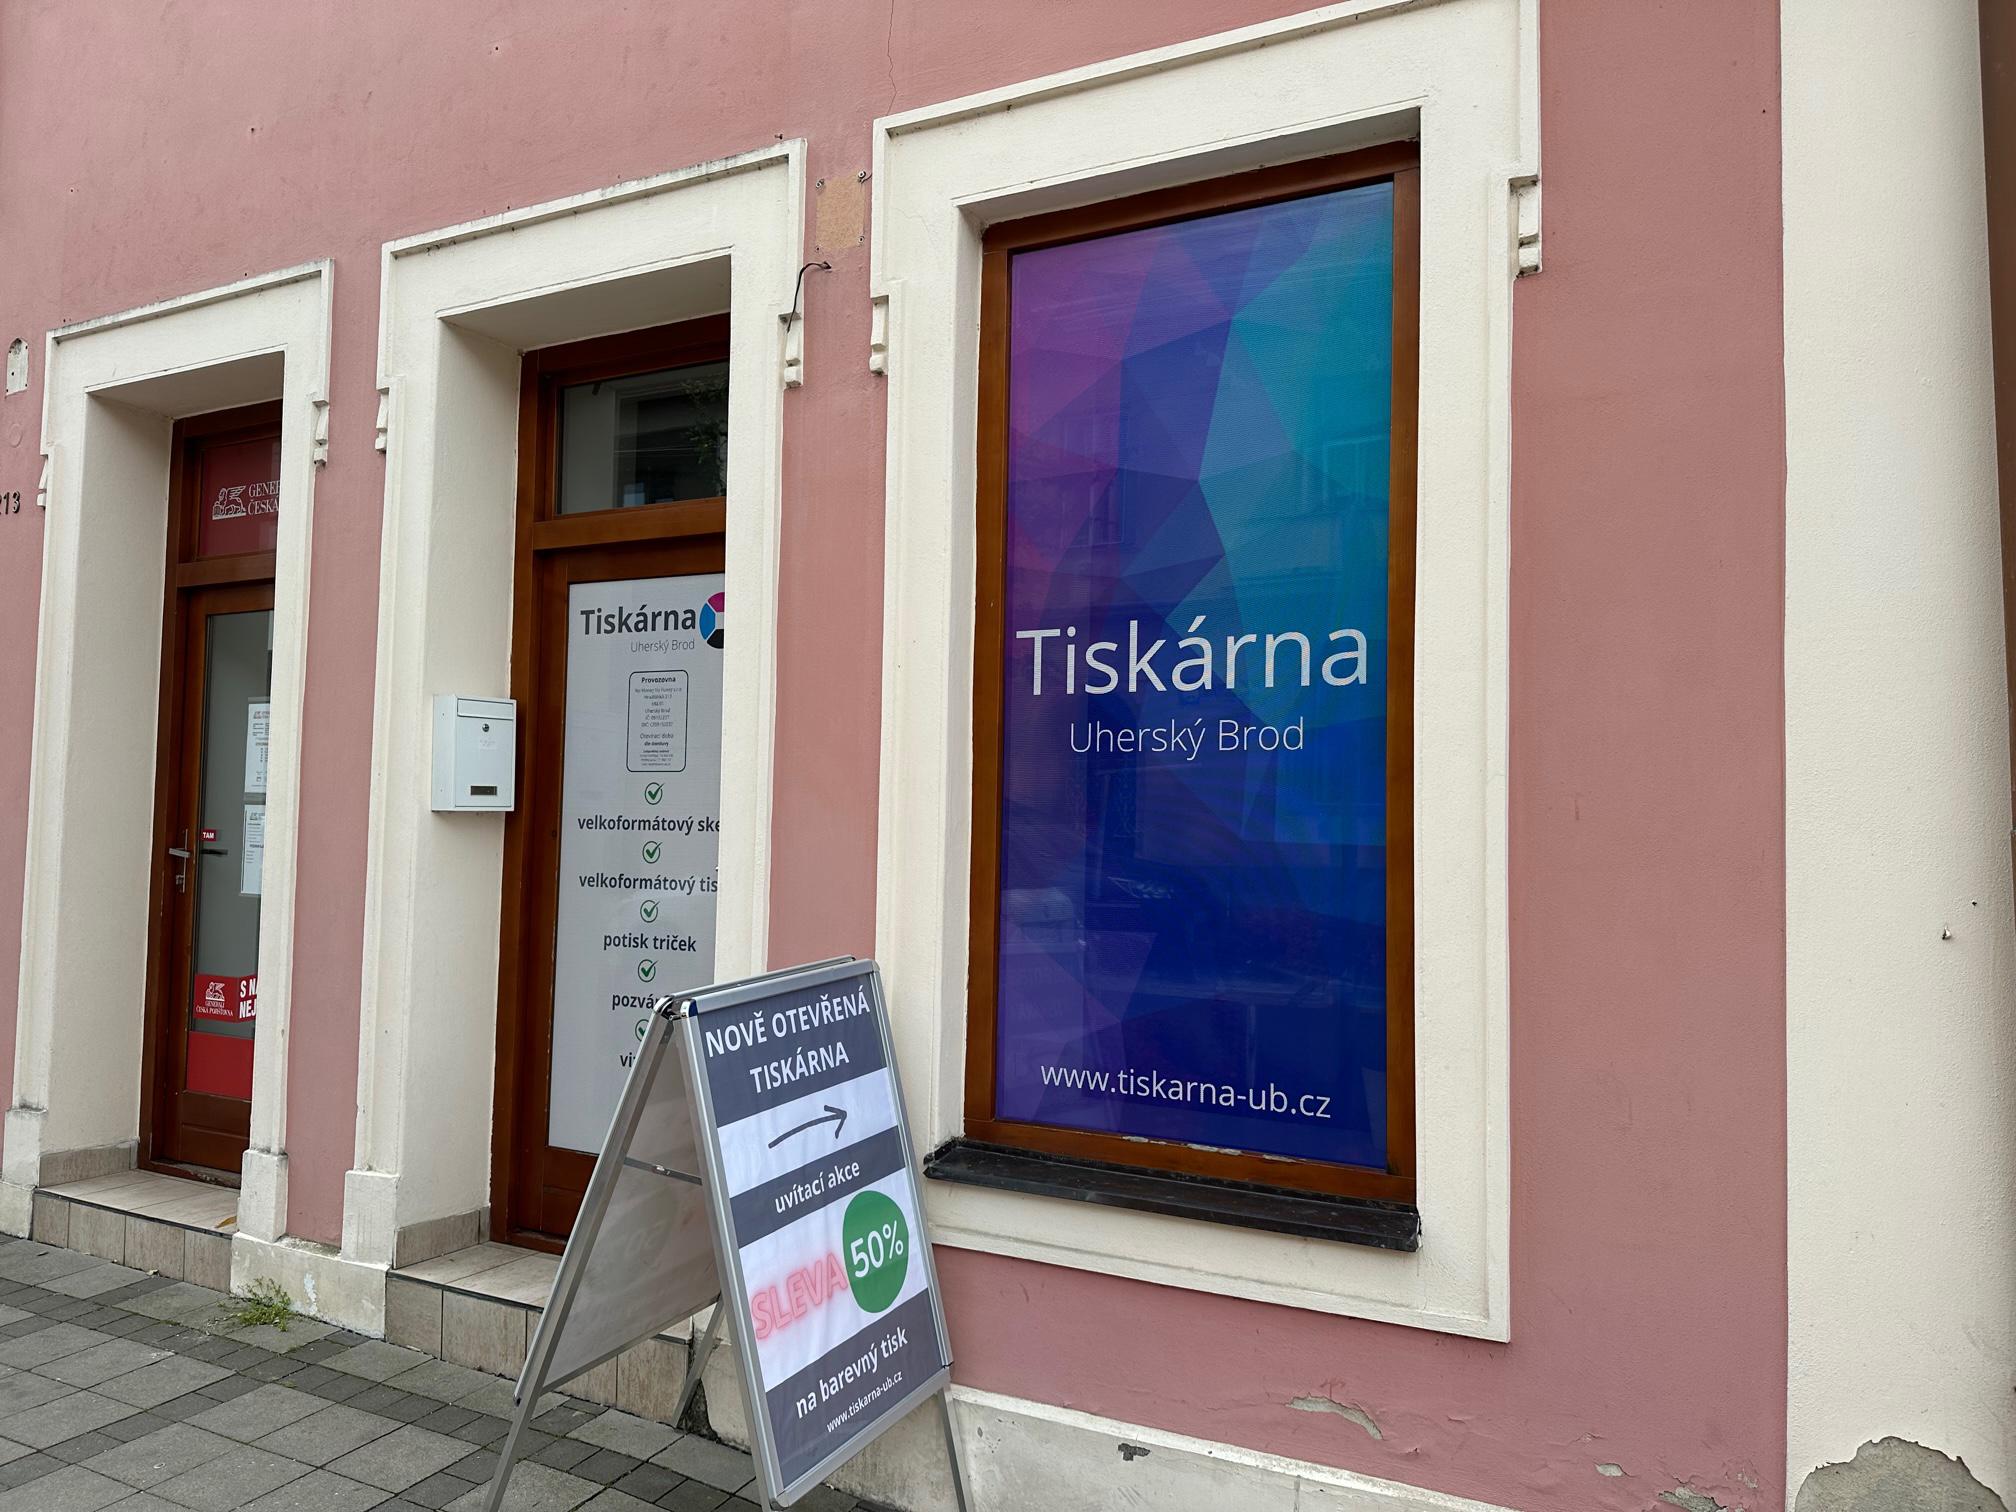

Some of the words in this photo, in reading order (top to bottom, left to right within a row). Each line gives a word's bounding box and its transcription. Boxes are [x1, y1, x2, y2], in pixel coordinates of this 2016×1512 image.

[0, 491, 21, 515] 13
[580, 604, 696, 635] Tiskárna
[630, 639, 670, 654] Uherský
[671, 638, 695, 651] Brod
[1015, 615, 1368, 696] Tiskárna
[1069, 718, 1206, 761] Uherský
[1217, 716, 1305, 751] Brod
[202, 831, 215, 839] TAM
[577, 815, 694, 836] velkoformátový
[578, 873, 696, 895] velkoformátový
[699, 876, 718, 892] tis
[603, 932, 649, 950] potisk
[652, 934, 697, 952] triček
[240, 980, 247, 998] S
[249, 978, 257, 996] N
[705, 1010, 768, 1057] NOVĚ
[771, 985, 871, 1038] OTEVŘENÁ
[620, 1052, 636, 1067] vi
[750, 1041, 850, 1093] TISKÁRNA
[1040, 1065, 1331, 1119] www.tiskarna-ub.cz
[774, 1172, 826, 1213] uvítací
[828, 1160, 860, 1189] akce
[750, 1252, 848, 1341] SLEVA
[850, 1220, 904, 1278] 50%
[796, 1395, 817, 1419] na
[819, 1342, 879, 1402] barevný
[881, 1327, 908, 1359] tisk
[826, 1370, 903, 1433] www.tiskarna-ub.cz
